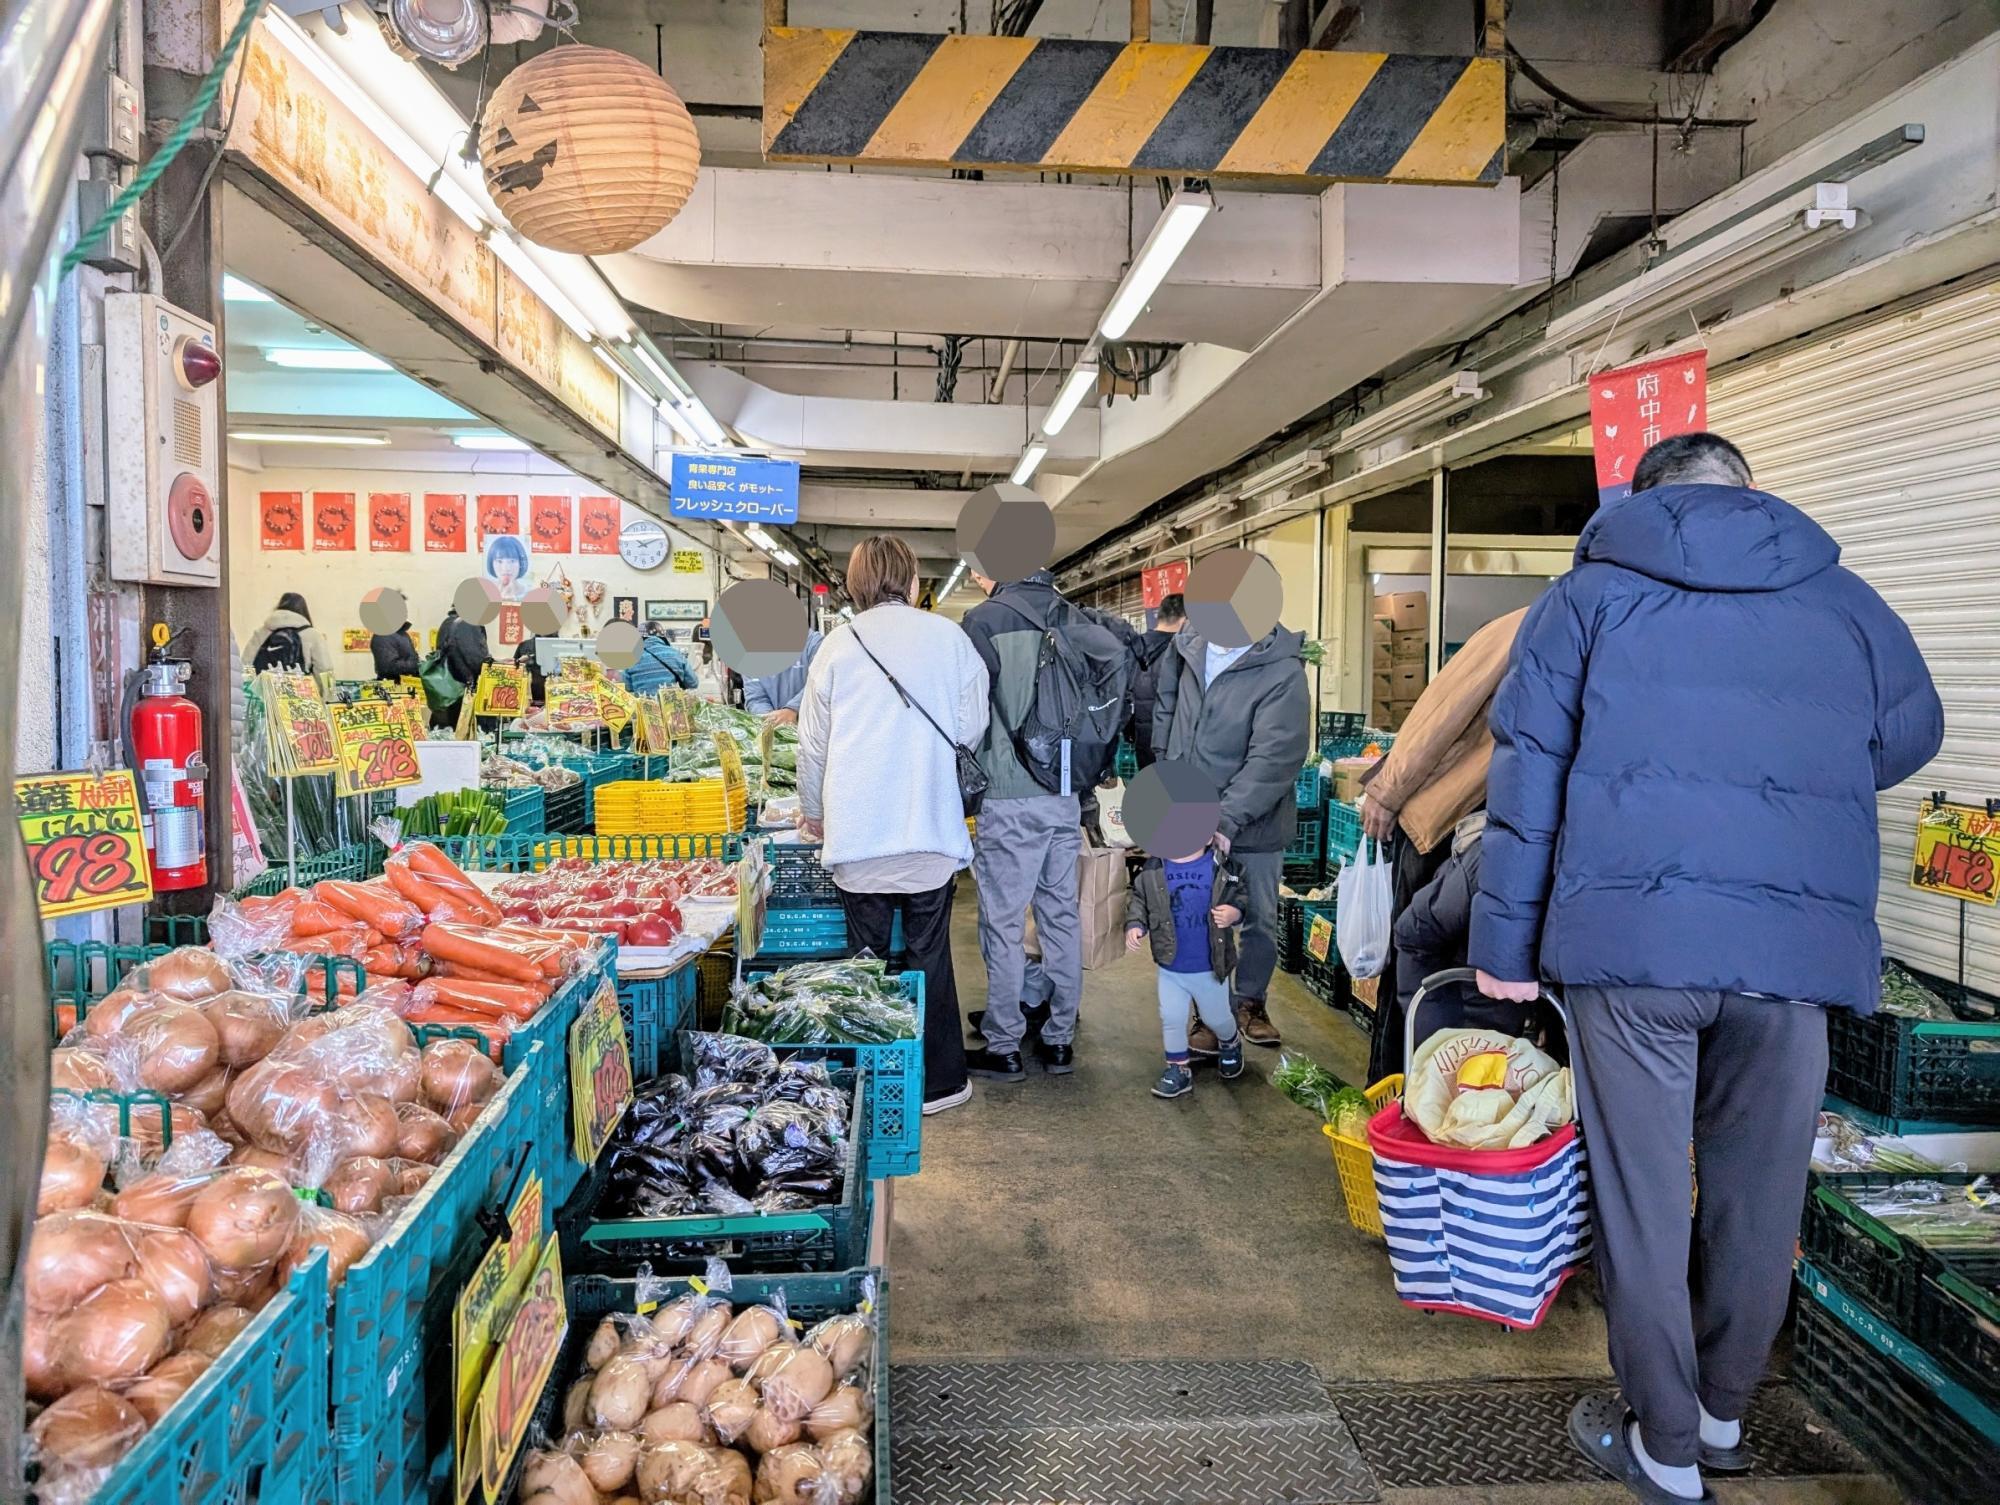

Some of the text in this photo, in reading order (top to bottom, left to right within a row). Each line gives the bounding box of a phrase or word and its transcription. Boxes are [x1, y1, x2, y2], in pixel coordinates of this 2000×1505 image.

[1637, 373, 1661, 447] 府中市
[688, 463, 736, 476] 青果専門店
[687, 479, 784, 494] 良い品安く がモットー
[674, 497, 794, 516] フレッシュクローバー
[920, 592, 932, 611] 4
[359, 738, 418, 783] 298
